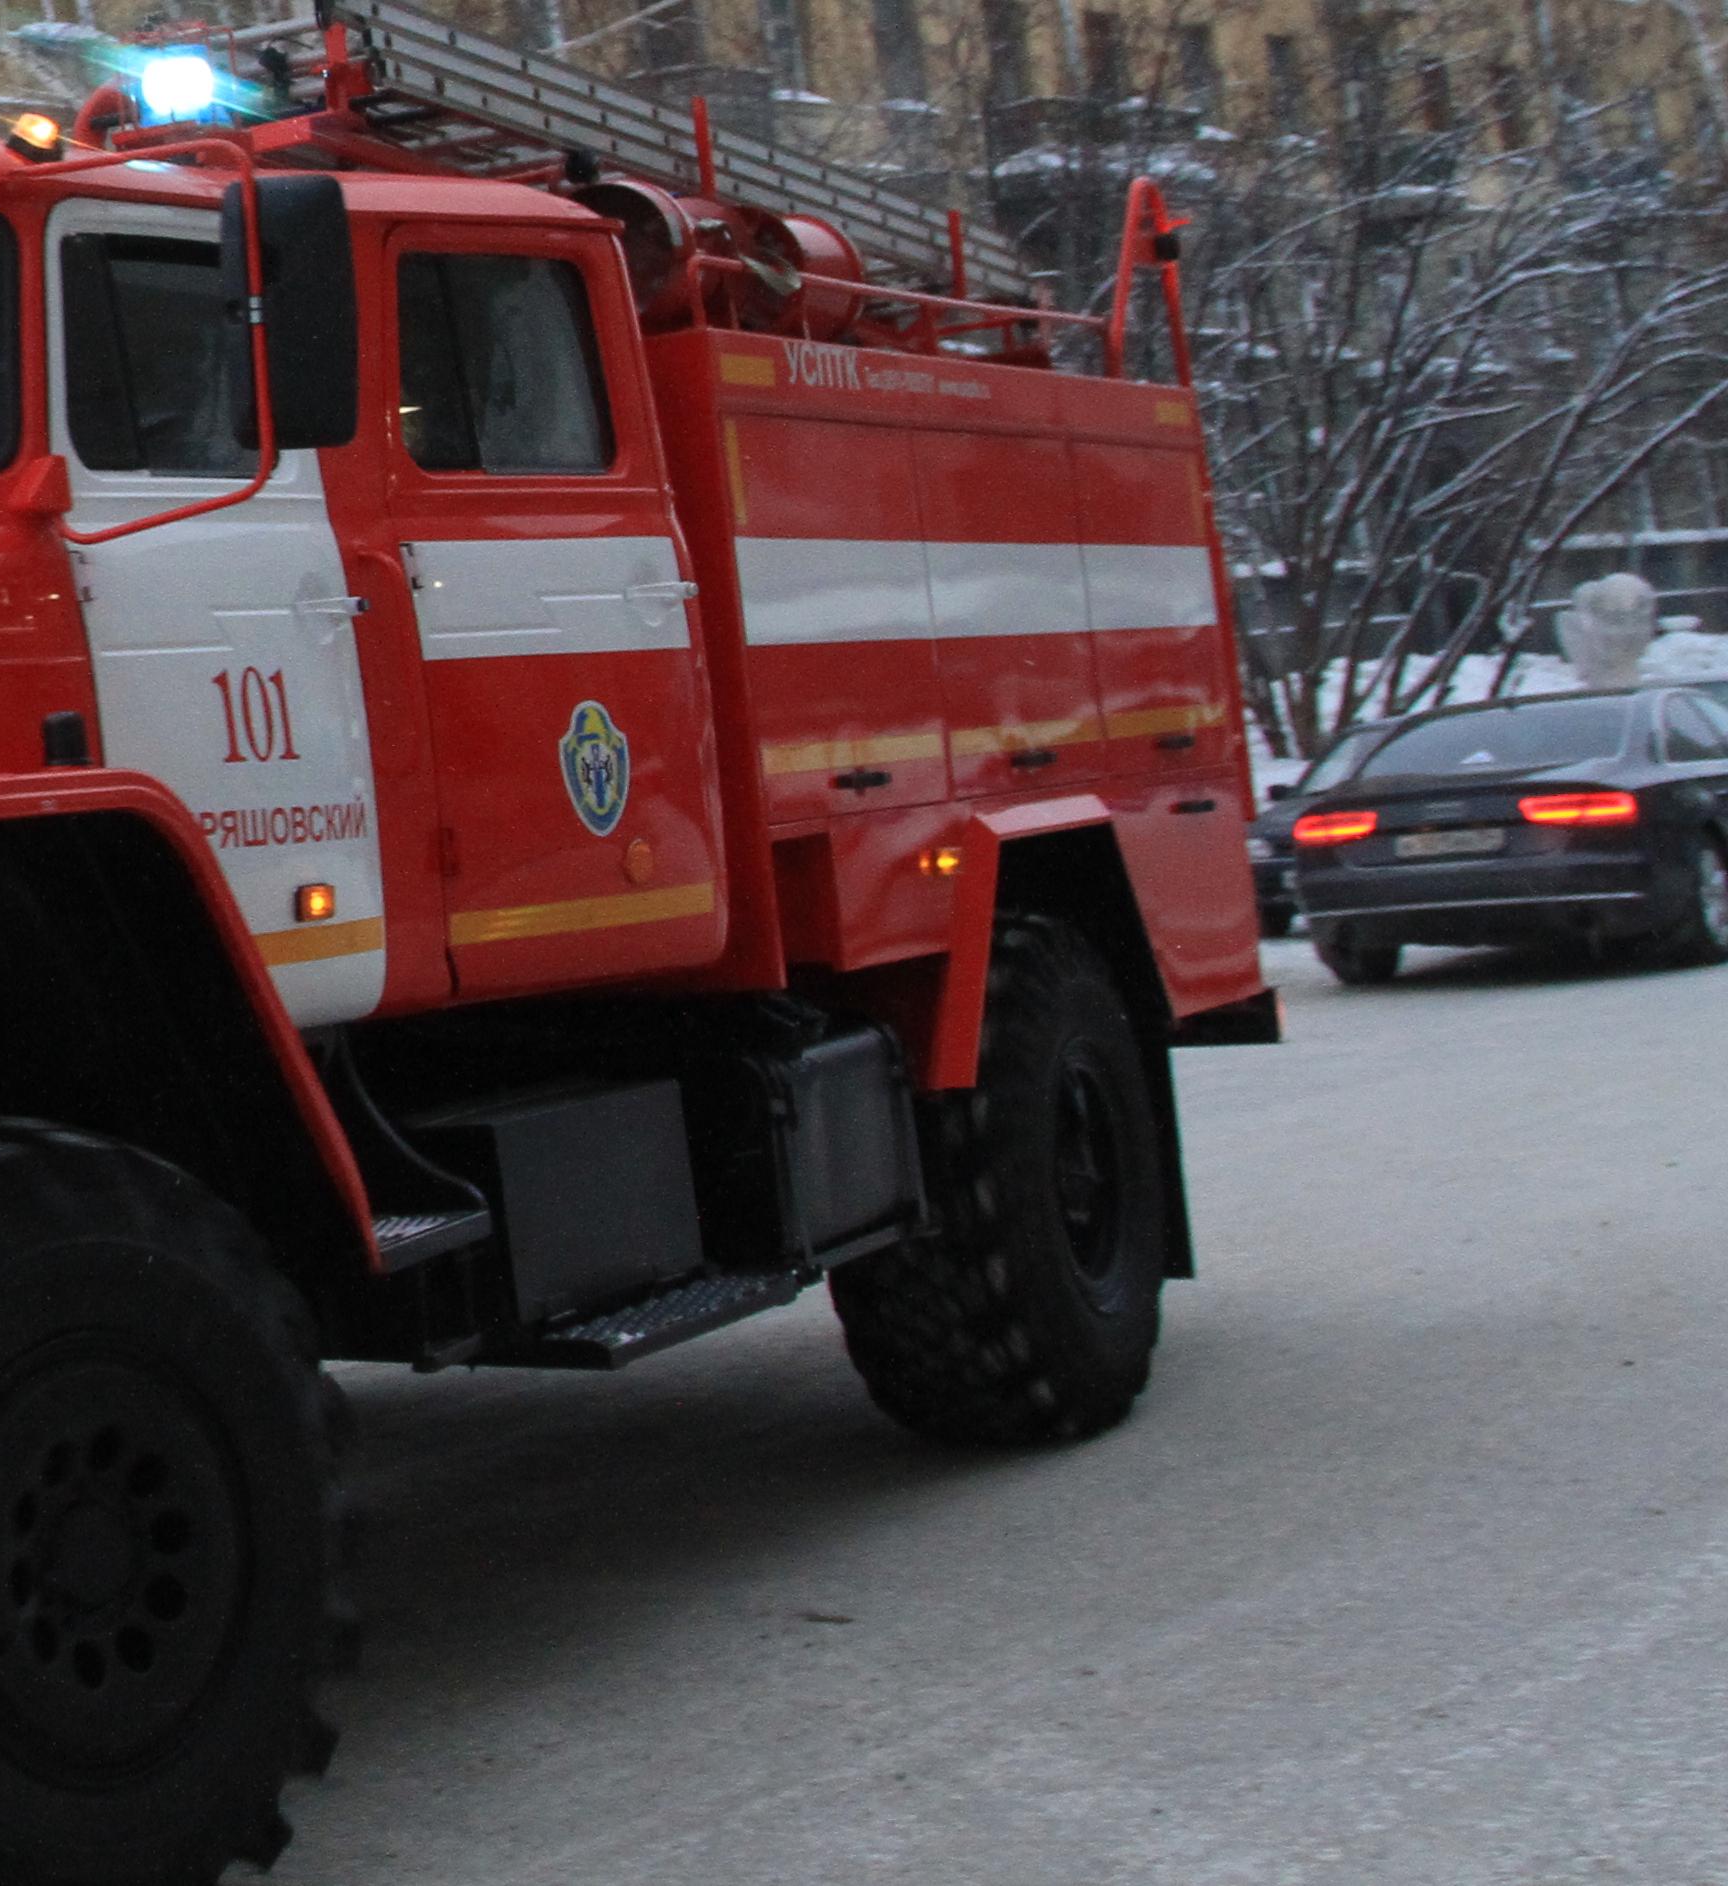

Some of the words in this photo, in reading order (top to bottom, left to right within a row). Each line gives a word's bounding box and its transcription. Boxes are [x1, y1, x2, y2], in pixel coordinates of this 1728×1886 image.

[783, 340, 861, 391] УСПТК
[211, 665, 301, 763] 101
[199, 794, 367, 849] РЯШОВСКИЙ
